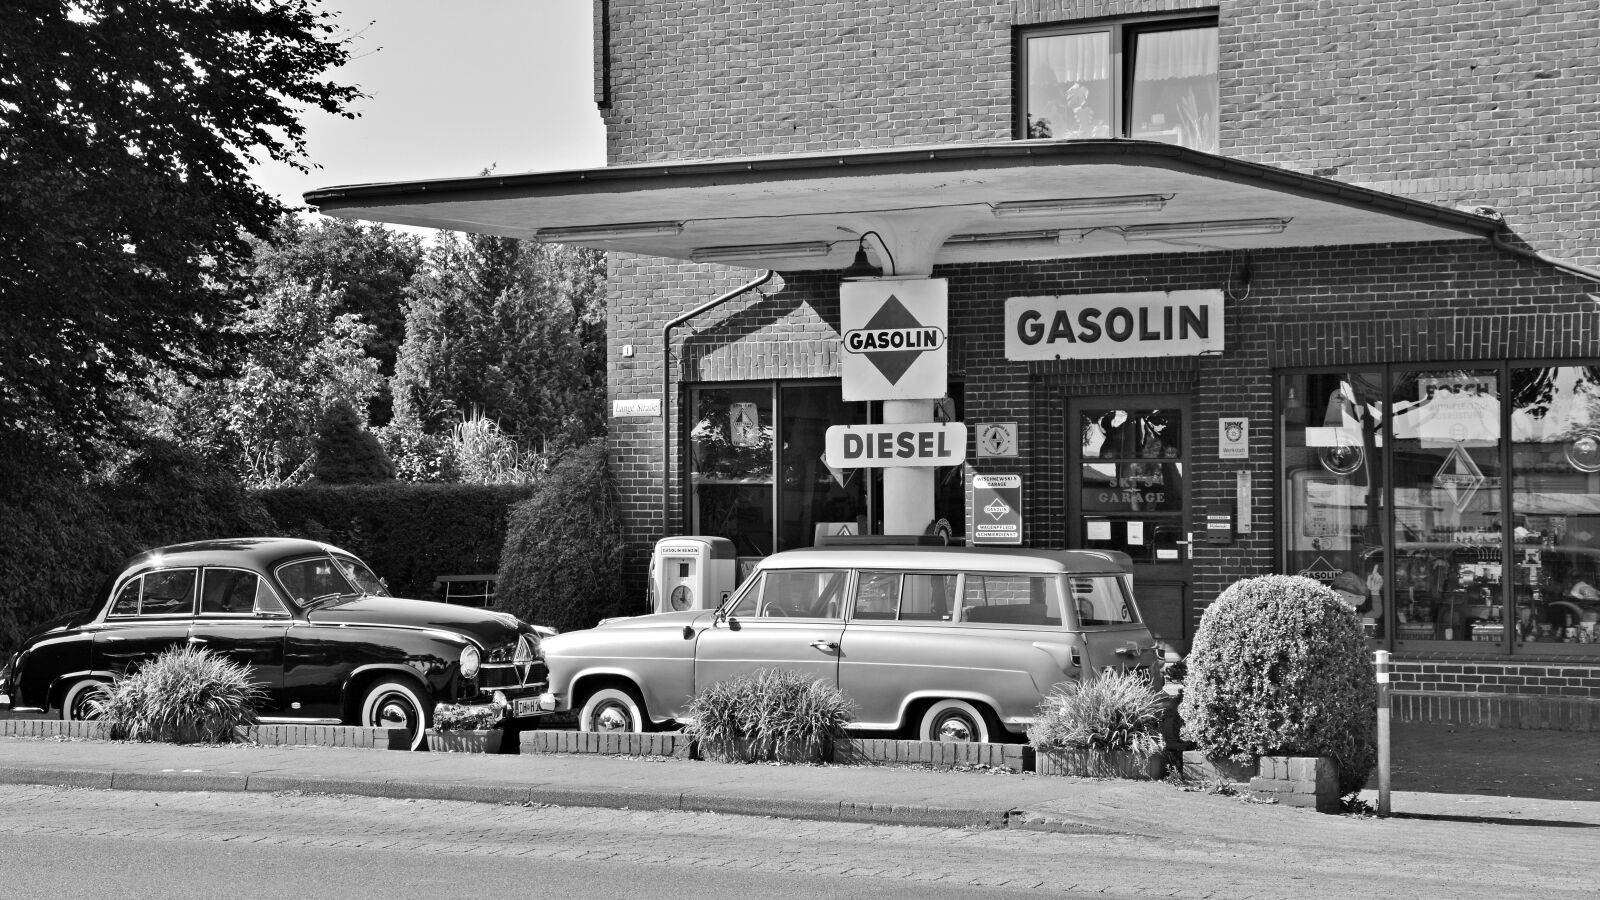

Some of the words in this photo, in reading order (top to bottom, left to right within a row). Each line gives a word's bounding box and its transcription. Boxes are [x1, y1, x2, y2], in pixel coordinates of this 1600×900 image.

[1016, 304, 1209, 346] GASOLIN
[849, 330, 937, 349] GASOLIN
[843, 431, 952, 459] DIESEL
[1098, 492, 1166, 503] GARAGE
